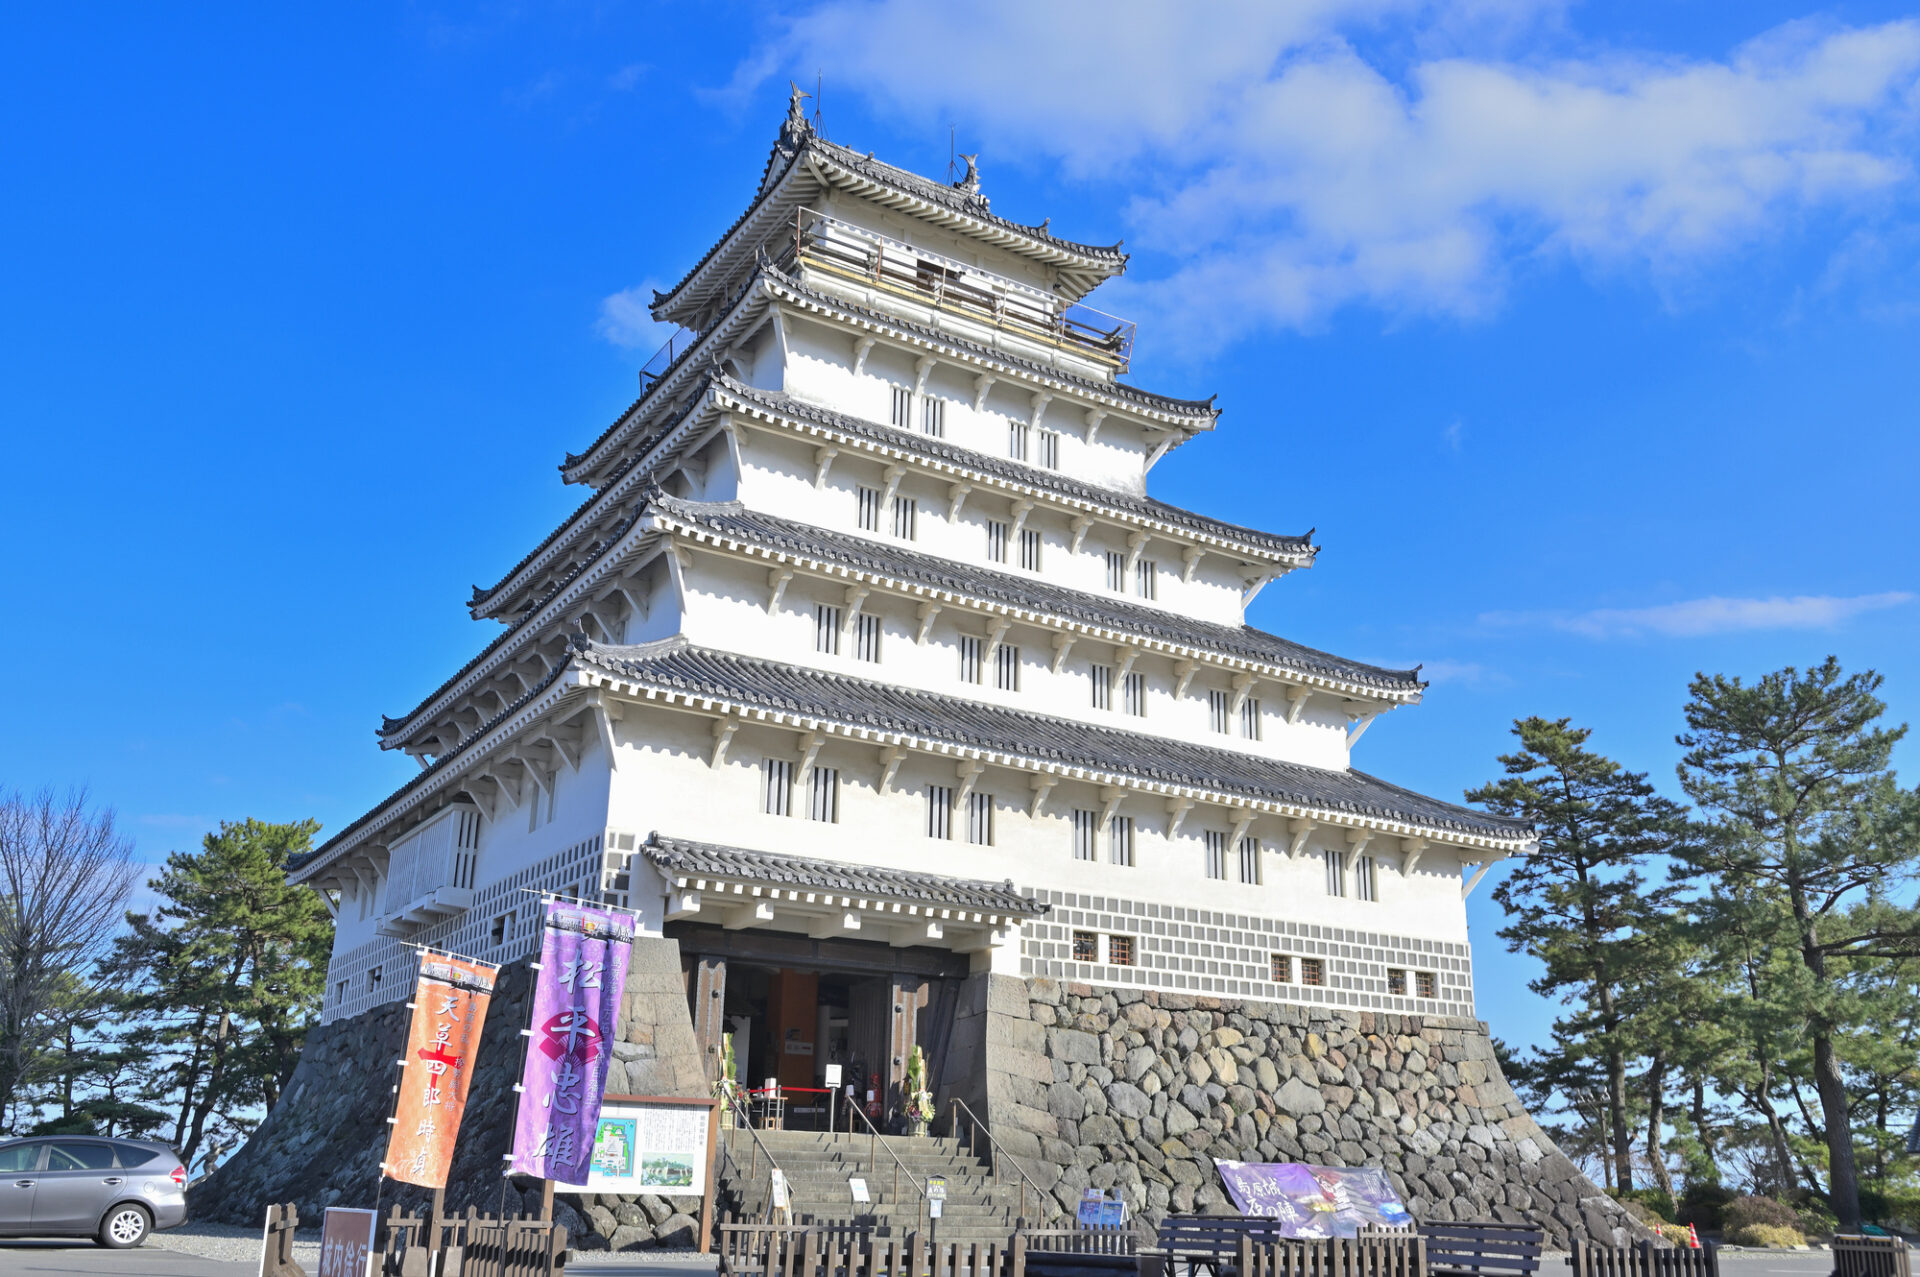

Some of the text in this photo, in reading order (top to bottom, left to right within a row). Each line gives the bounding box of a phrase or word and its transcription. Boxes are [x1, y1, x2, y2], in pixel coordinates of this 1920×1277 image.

[409, 995, 460, 1177] 天草四郎時貞
[533, 948, 607, 1170] 松平忠雄
[1235, 1174, 1288, 1199] 島原城
[1245, 1195, 1299, 1224] 夜の陣
